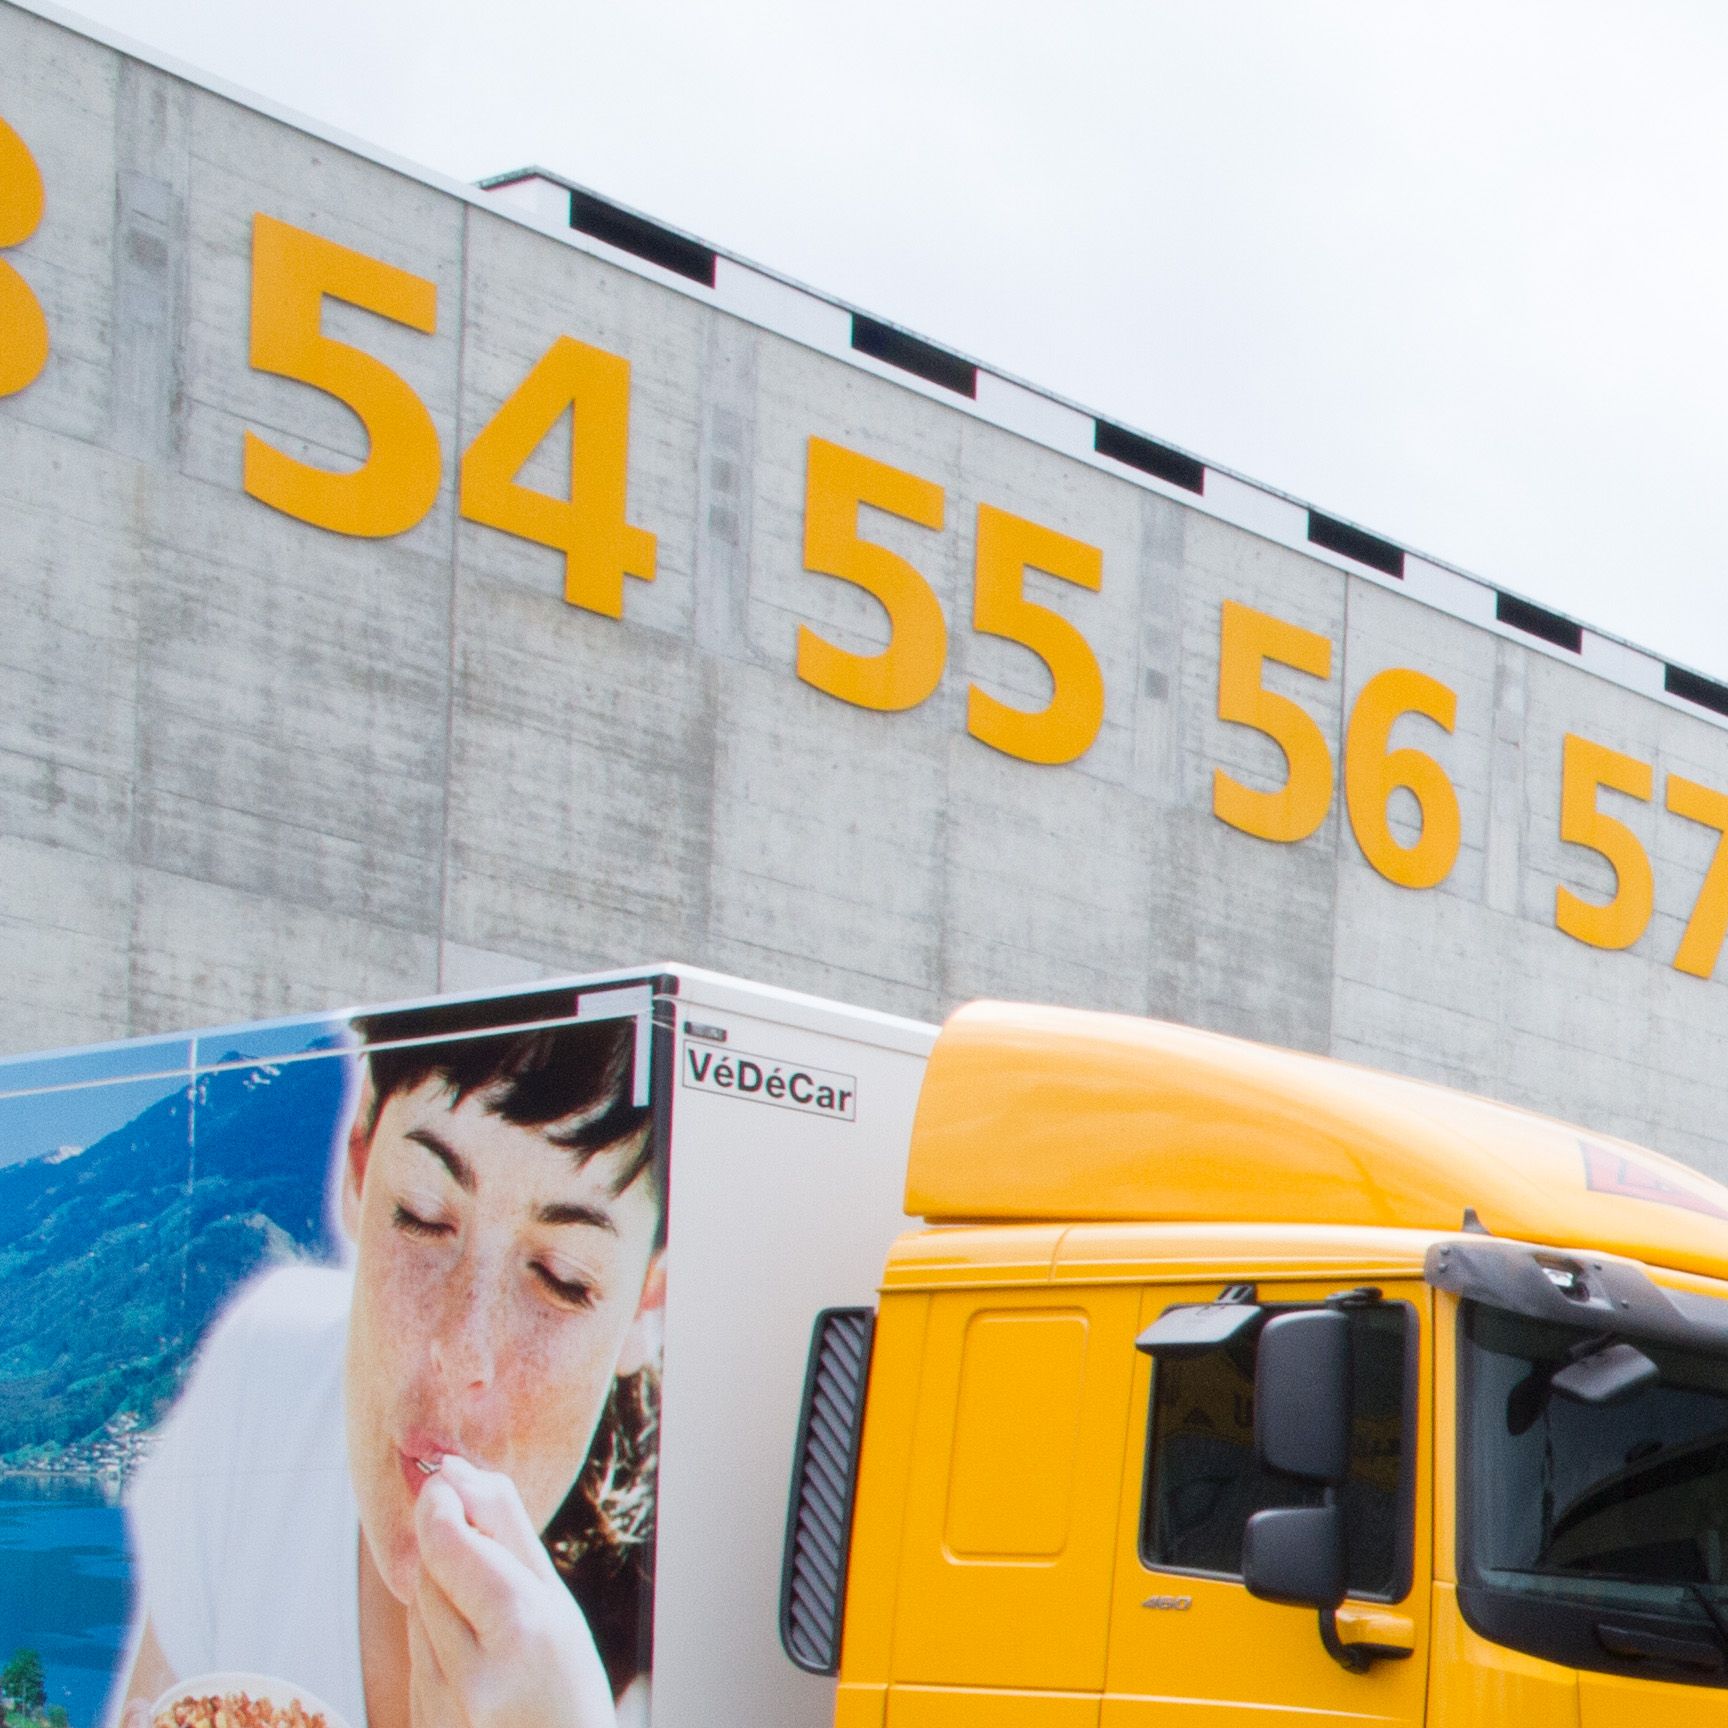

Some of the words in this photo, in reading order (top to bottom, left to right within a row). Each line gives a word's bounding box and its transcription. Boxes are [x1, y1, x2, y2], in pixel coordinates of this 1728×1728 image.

[244, 212, 657, 620] 54
[797, 435, 1104, 766] 55
[1213, 600, 1461, 889] 56
[688, 1048, 852, 1112] VéDéCar
